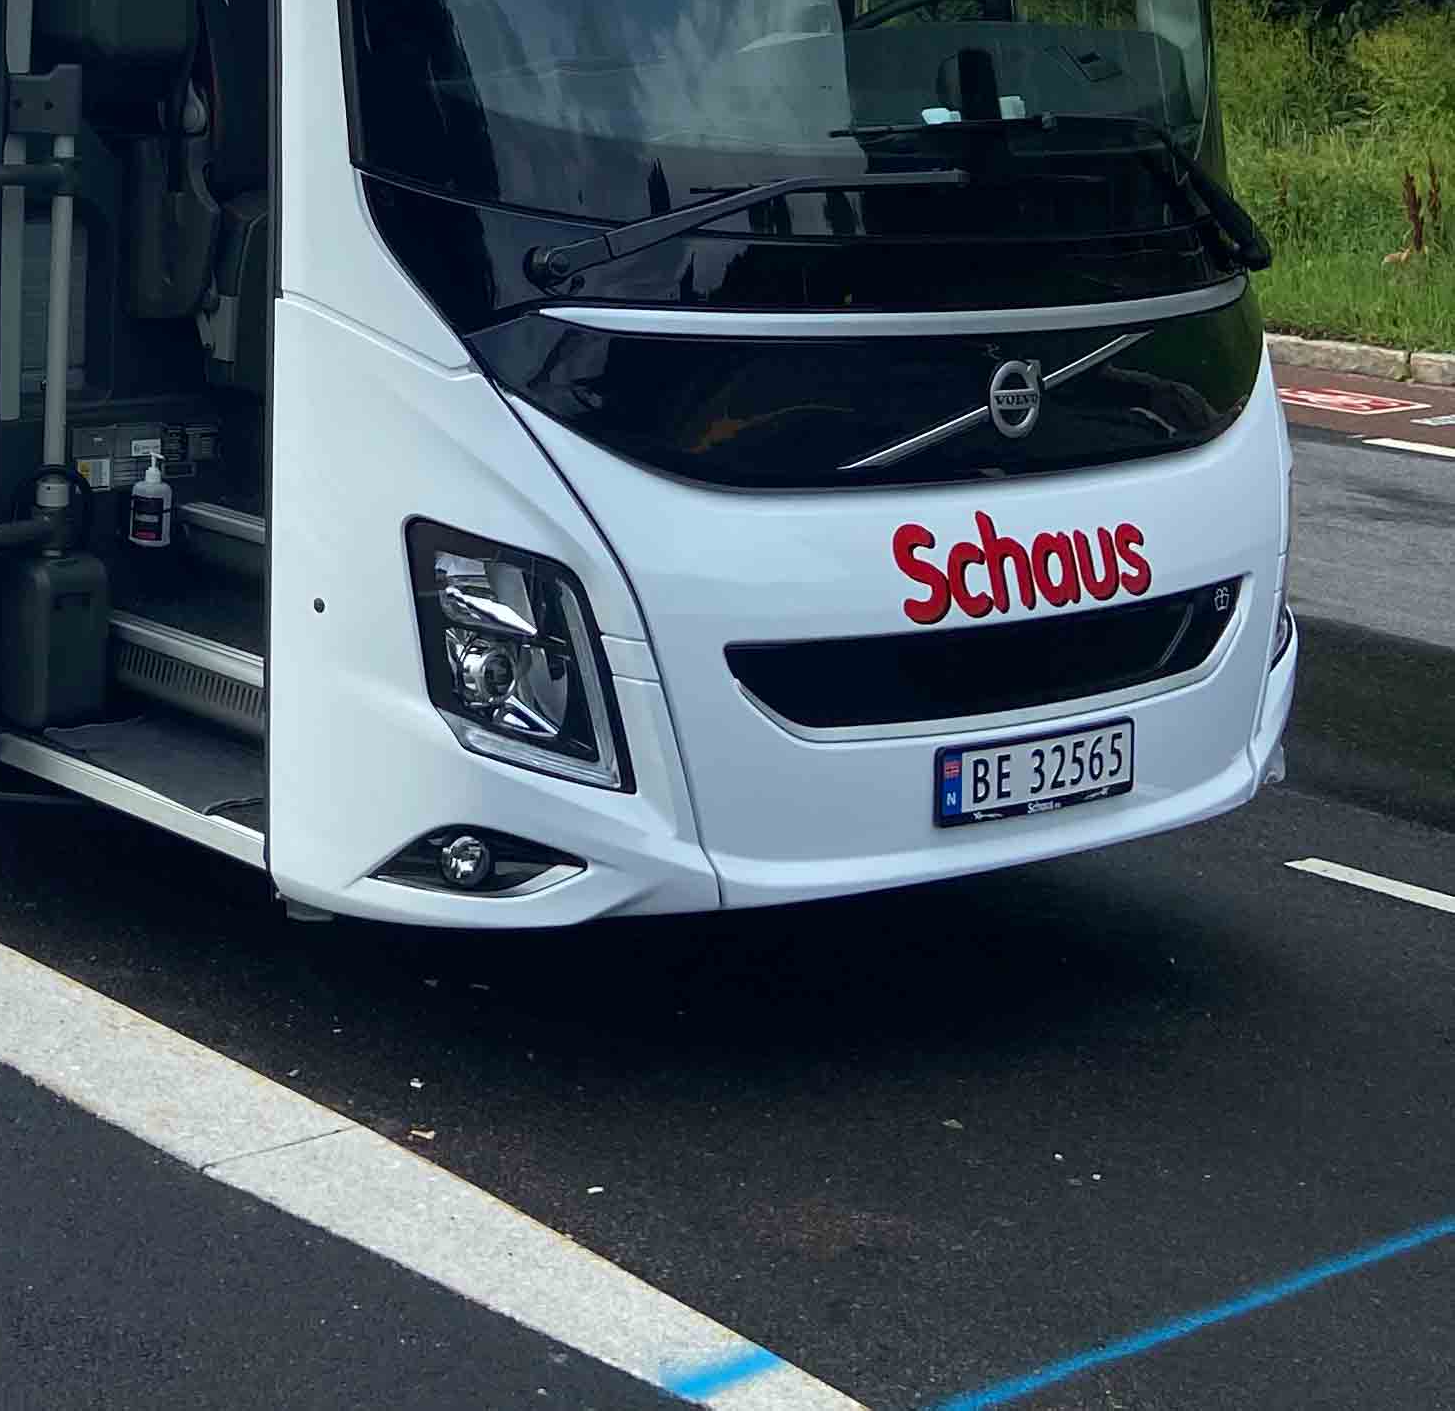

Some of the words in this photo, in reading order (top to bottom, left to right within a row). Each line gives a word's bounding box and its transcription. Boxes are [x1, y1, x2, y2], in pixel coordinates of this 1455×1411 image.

[993, 394, 1038, 406] VOLVO
[892, 510, 1153, 625] Schaus
[972, 754, 1012, 804] BE
[1030, 732, 1124, 795] 32565
[946, 792, 957, 806] N
